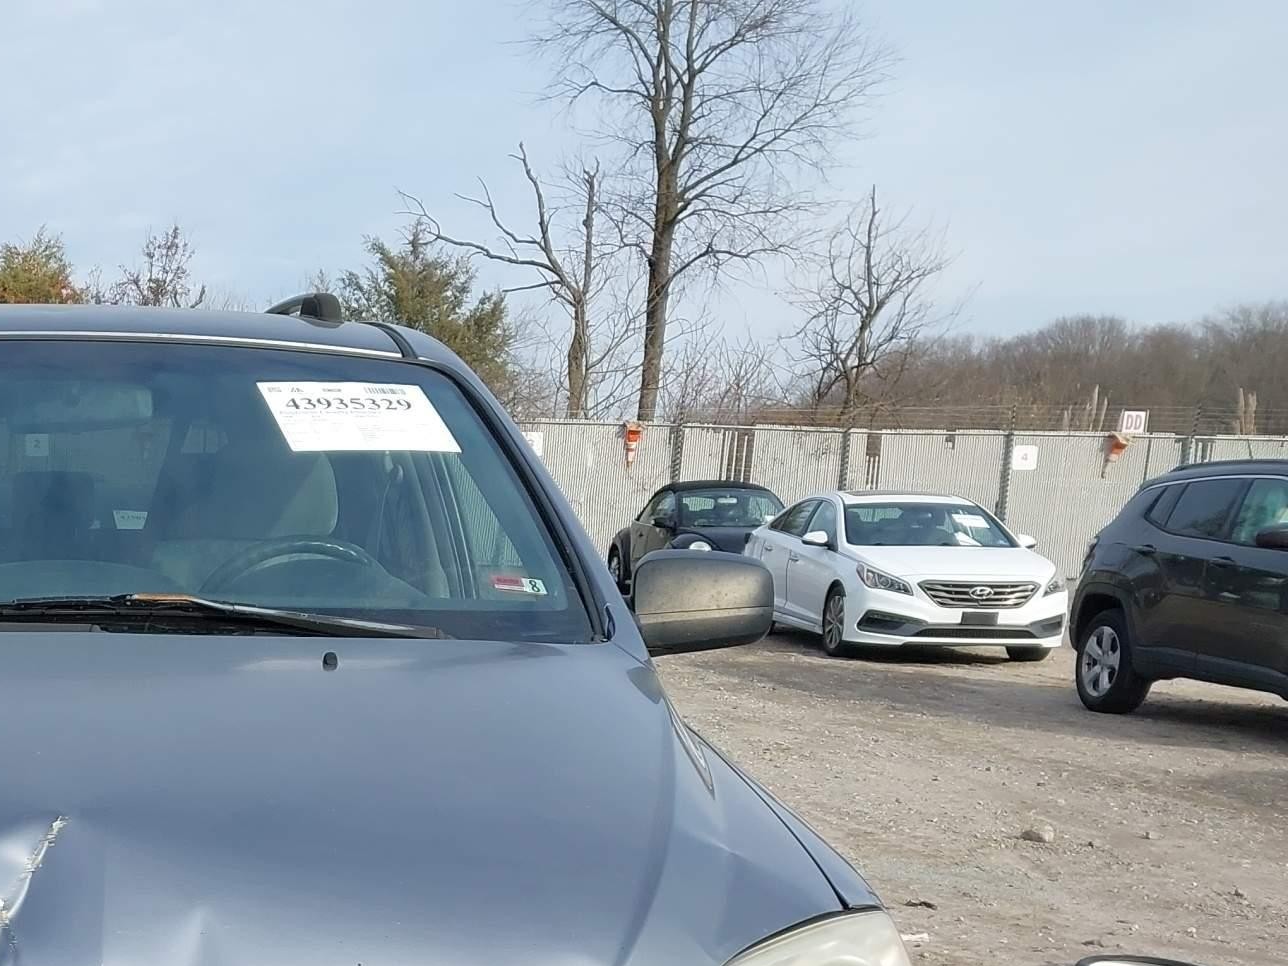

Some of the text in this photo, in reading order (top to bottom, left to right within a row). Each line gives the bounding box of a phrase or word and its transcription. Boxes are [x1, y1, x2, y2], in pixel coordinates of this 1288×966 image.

[285, 397, 412, 411] 43935329
[1125, 414, 1142, 430] DD
[529, 580, 541, 593] 8
